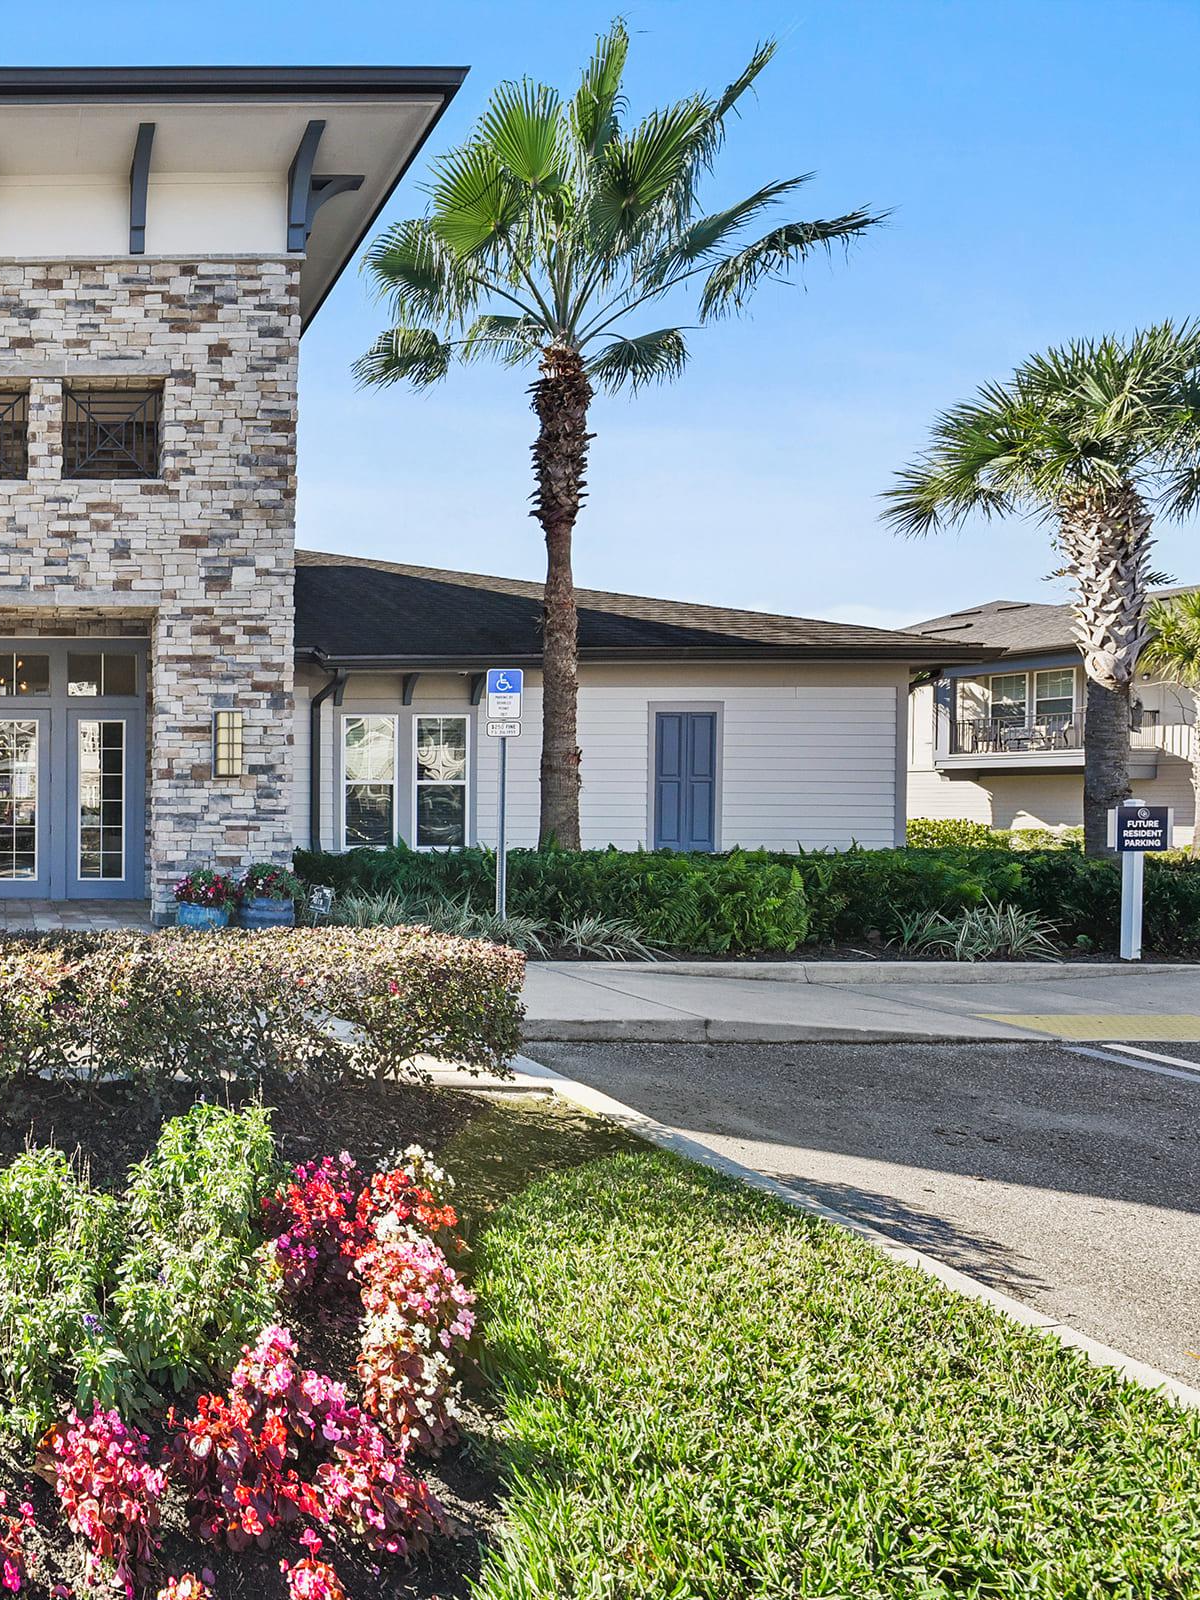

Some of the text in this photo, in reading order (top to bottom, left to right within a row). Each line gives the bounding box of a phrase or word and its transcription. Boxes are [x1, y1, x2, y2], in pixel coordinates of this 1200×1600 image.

[1127, 820, 1160, 828] FUTURE
[1122, 829, 1163, 838] RESIDENT
[1124, 839, 1161, 847] PARKING
